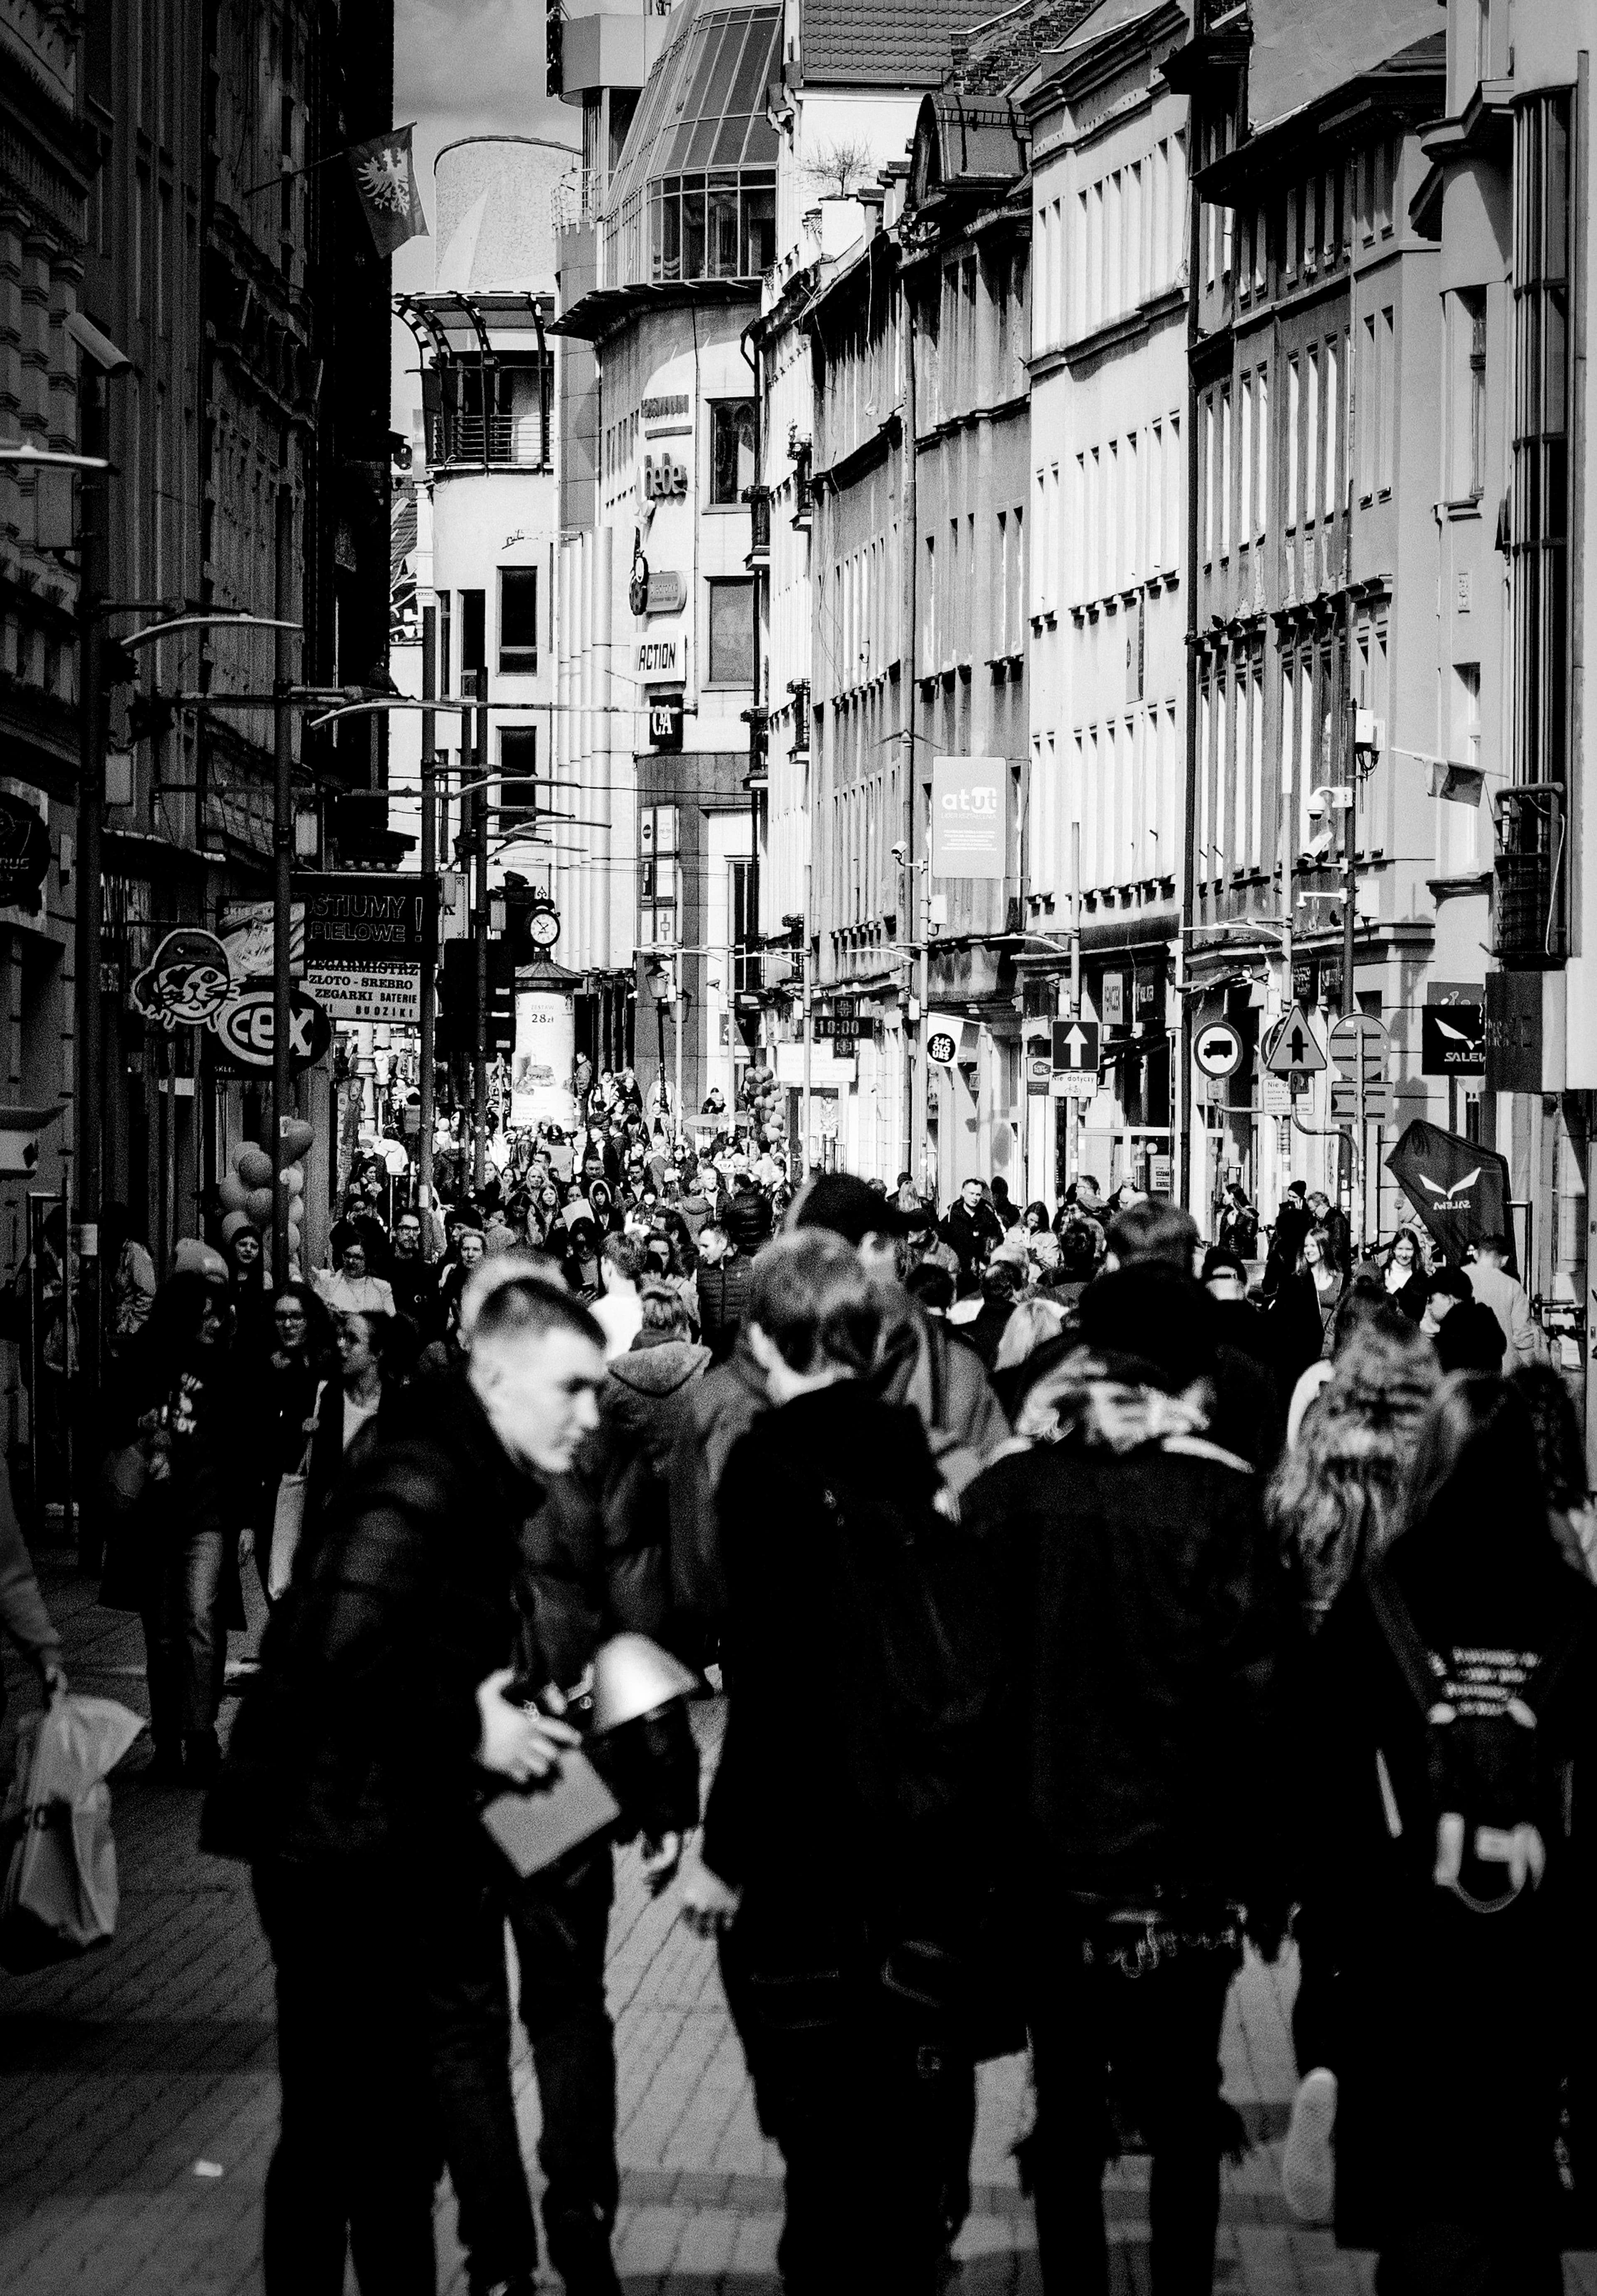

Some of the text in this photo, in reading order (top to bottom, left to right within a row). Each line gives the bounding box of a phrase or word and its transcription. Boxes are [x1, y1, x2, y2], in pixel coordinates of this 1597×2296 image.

[644, 453, 687, 497] hebe
[637, 642, 676, 671] ACTION
[291, 893, 406, 919] OSTIUMY
[307, 921, 406, 942] PIELOWE
[309, 975, 351, 985] ZŁOTO
[361, 978, 413, 990] SREBRO
[315, 989, 417, 1004] ZEGARKI BATERIE
[356, 1005, 413, 1017] BUDZIKI
[1444, 1052, 1486, 1062] SALEW
[1067, 1075, 1095, 1083] dotyczy
